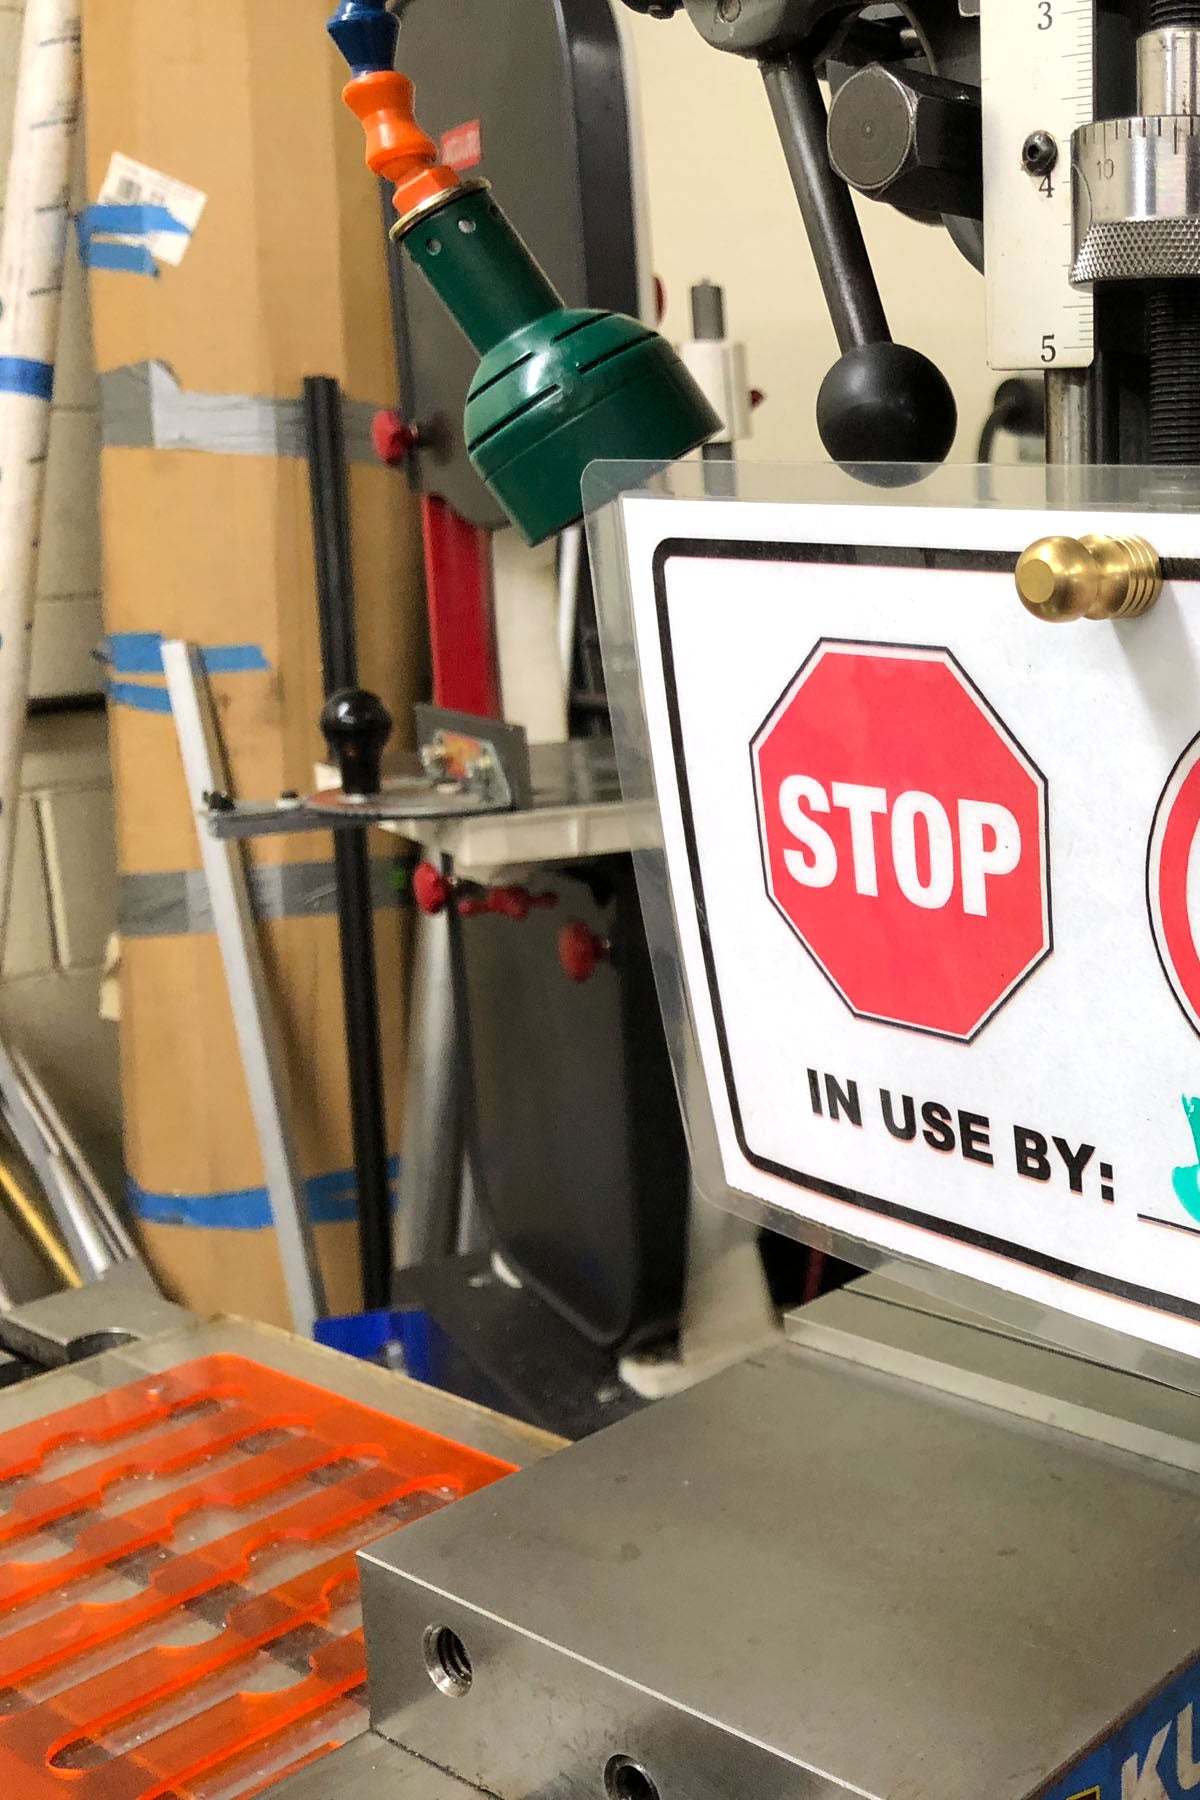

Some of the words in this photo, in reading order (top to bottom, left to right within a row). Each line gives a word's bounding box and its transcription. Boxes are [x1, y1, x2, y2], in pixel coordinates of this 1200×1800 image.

[1037, 1, 1053, 30] 3
[1097, 158, 1114, 180] 10
[1039, 170, 1055, 198] 4
[1040, 335, 1056, 362] 5
[778, 774, 1022, 917] STOP
[806, 1067, 863, 1129] IN
[879, 1087, 994, 1168] USE
[1013, 1124, 1115, 1205] BY:
